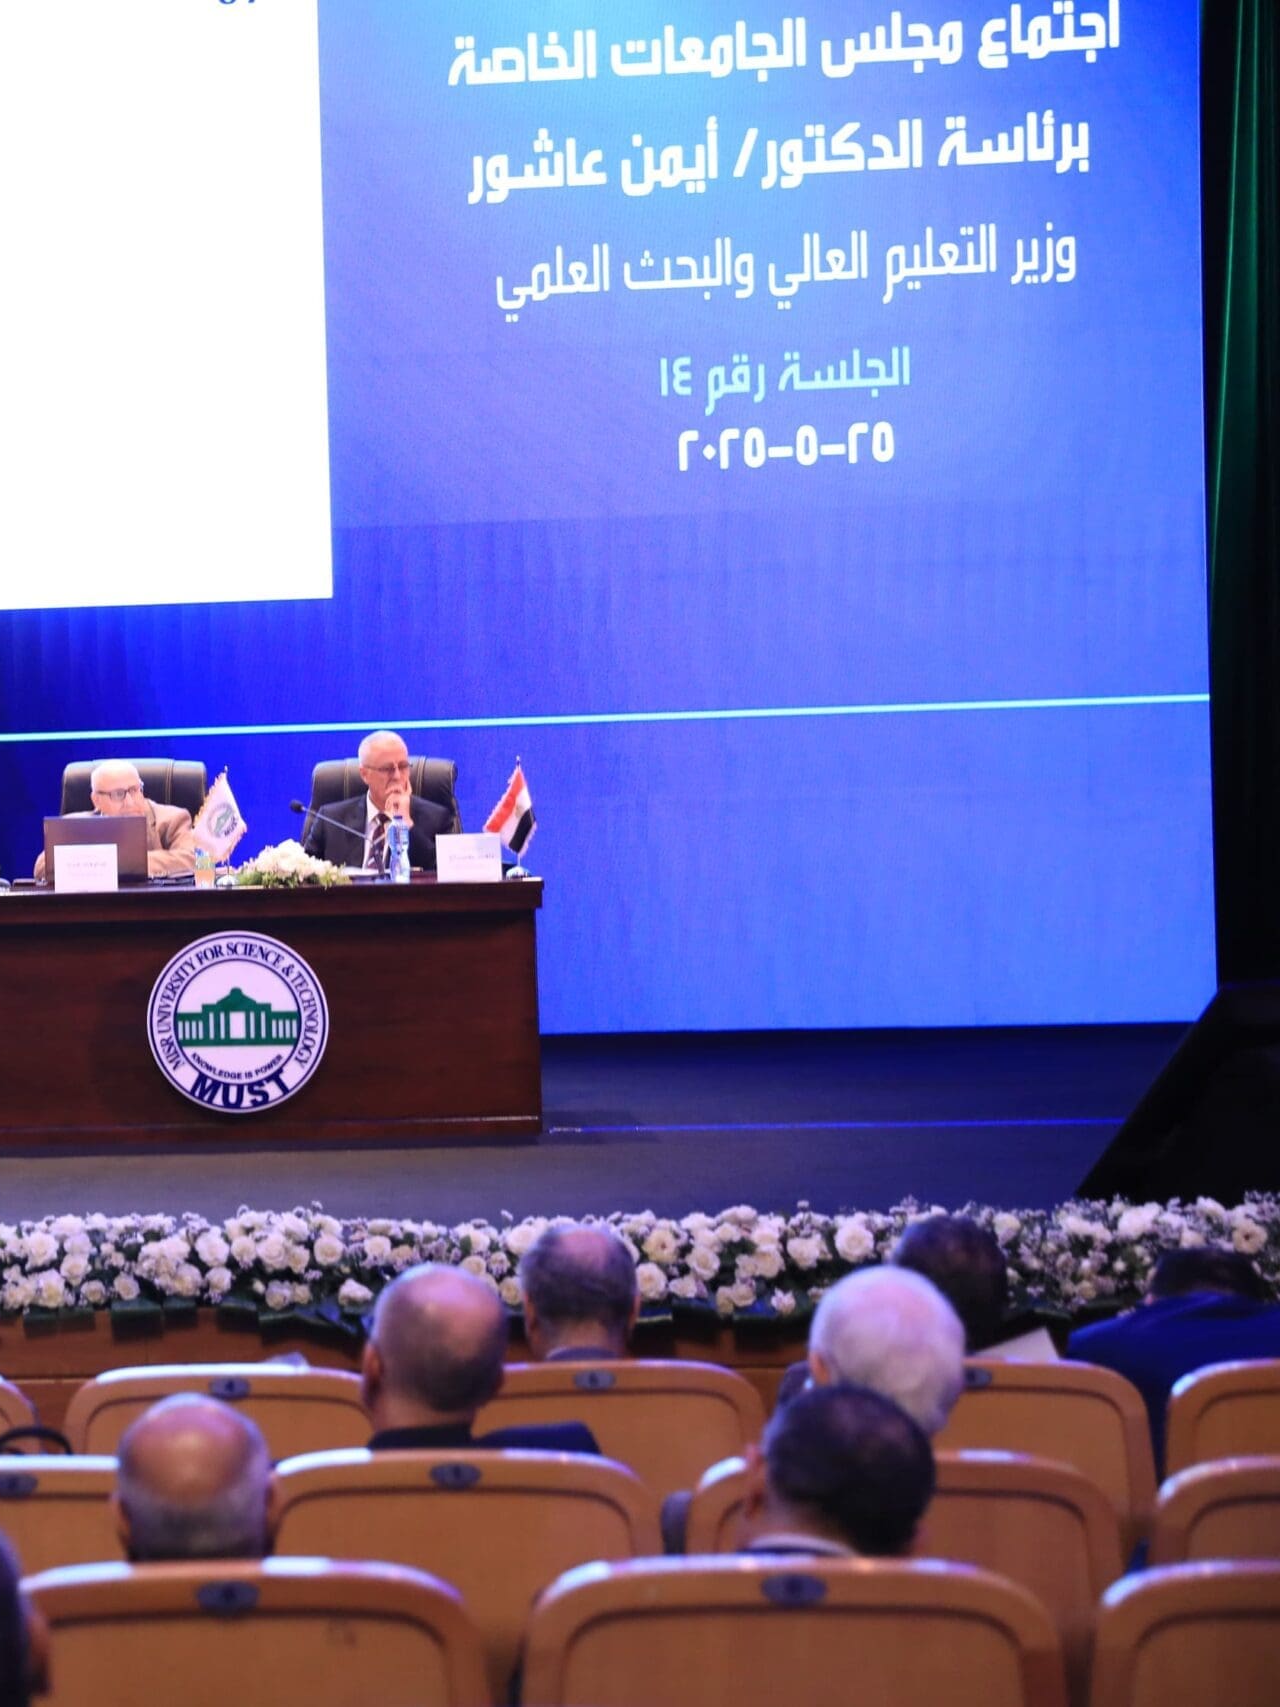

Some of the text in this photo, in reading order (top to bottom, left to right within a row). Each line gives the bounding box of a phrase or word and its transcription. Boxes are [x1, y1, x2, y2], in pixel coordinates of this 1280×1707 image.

[448, 0, 1120, 86] اجتماع مجلس الجامعات الخاصة
[468, 128, 607, 204] عاشور
[622, 116, 718, 196] أيمن
[939, 110, 1089, 172] برئاسة
[497, 222, 1076, 323] وزير التعليم العالي والبحث العلمي
[661, 347, 910, 415] الجلسة رقم ١٤
[157, 941, 318, 1070] MISR UNIVERSITY FOR SCIENCE & TECHNOLOGY
[190, 1067, 290, 1109] MUST
[191, 1052, 283, 1080] KNOWLEDGE IS POWER
